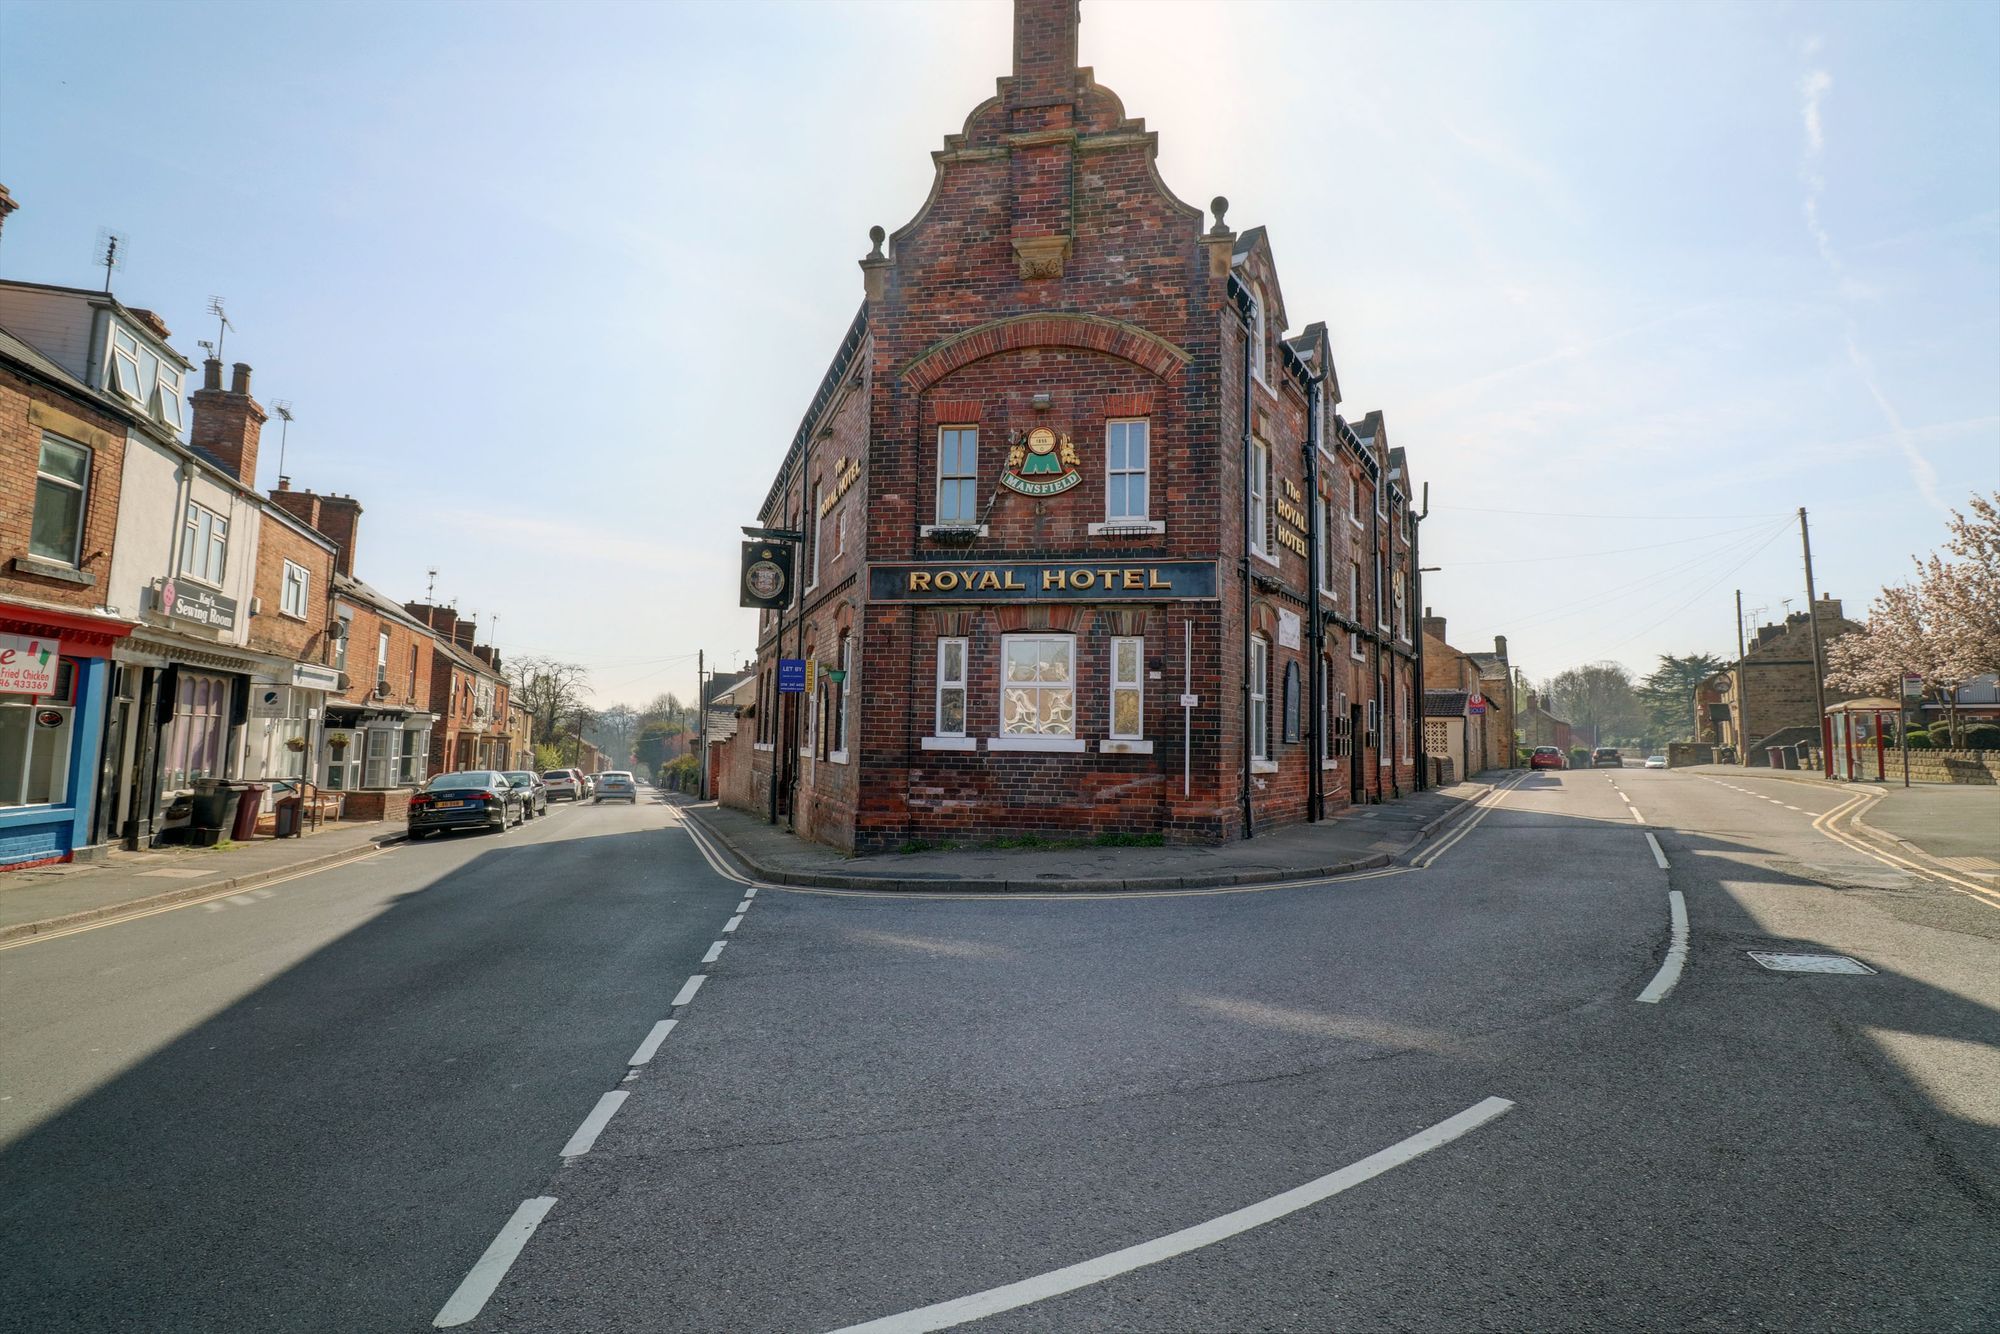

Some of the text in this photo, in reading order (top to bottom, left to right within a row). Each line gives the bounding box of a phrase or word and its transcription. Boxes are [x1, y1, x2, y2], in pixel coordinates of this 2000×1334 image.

[838, 458, 861, 497] HOTEL
[1006, 473, 1078, 494] MANSFIELD
[1283, 476, 1301, 503] The
[1277, 498, 1307, 532] ROYAL
[1278, 524, 1308, 559] HOTEL
[909, 568, 1172, 591] ROYAL HOTEL
[175, 598, 232, 628] Sewing Room
[1, 667, 50, 681] Fried Chicken
[13, 680, 48, 690] 433369
